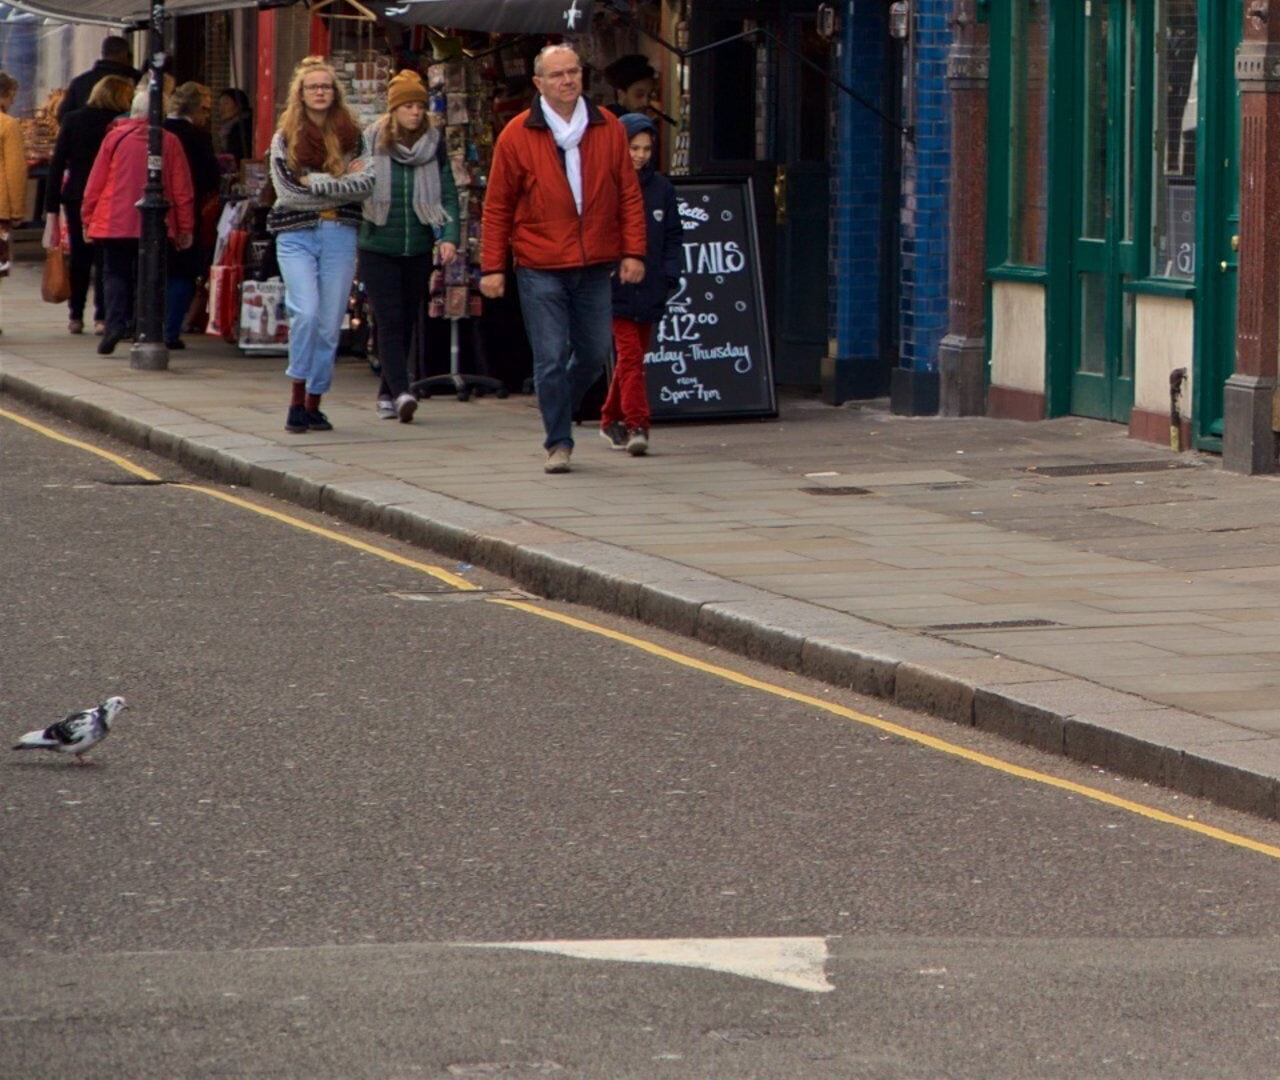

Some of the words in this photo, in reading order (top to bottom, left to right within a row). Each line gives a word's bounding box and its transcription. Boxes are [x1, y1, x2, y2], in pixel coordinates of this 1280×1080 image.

[681, 241, 745, 274] TAILS
[666, 277, 692, 306] 2
[643, 342, 751, 375] nday-Thursday
